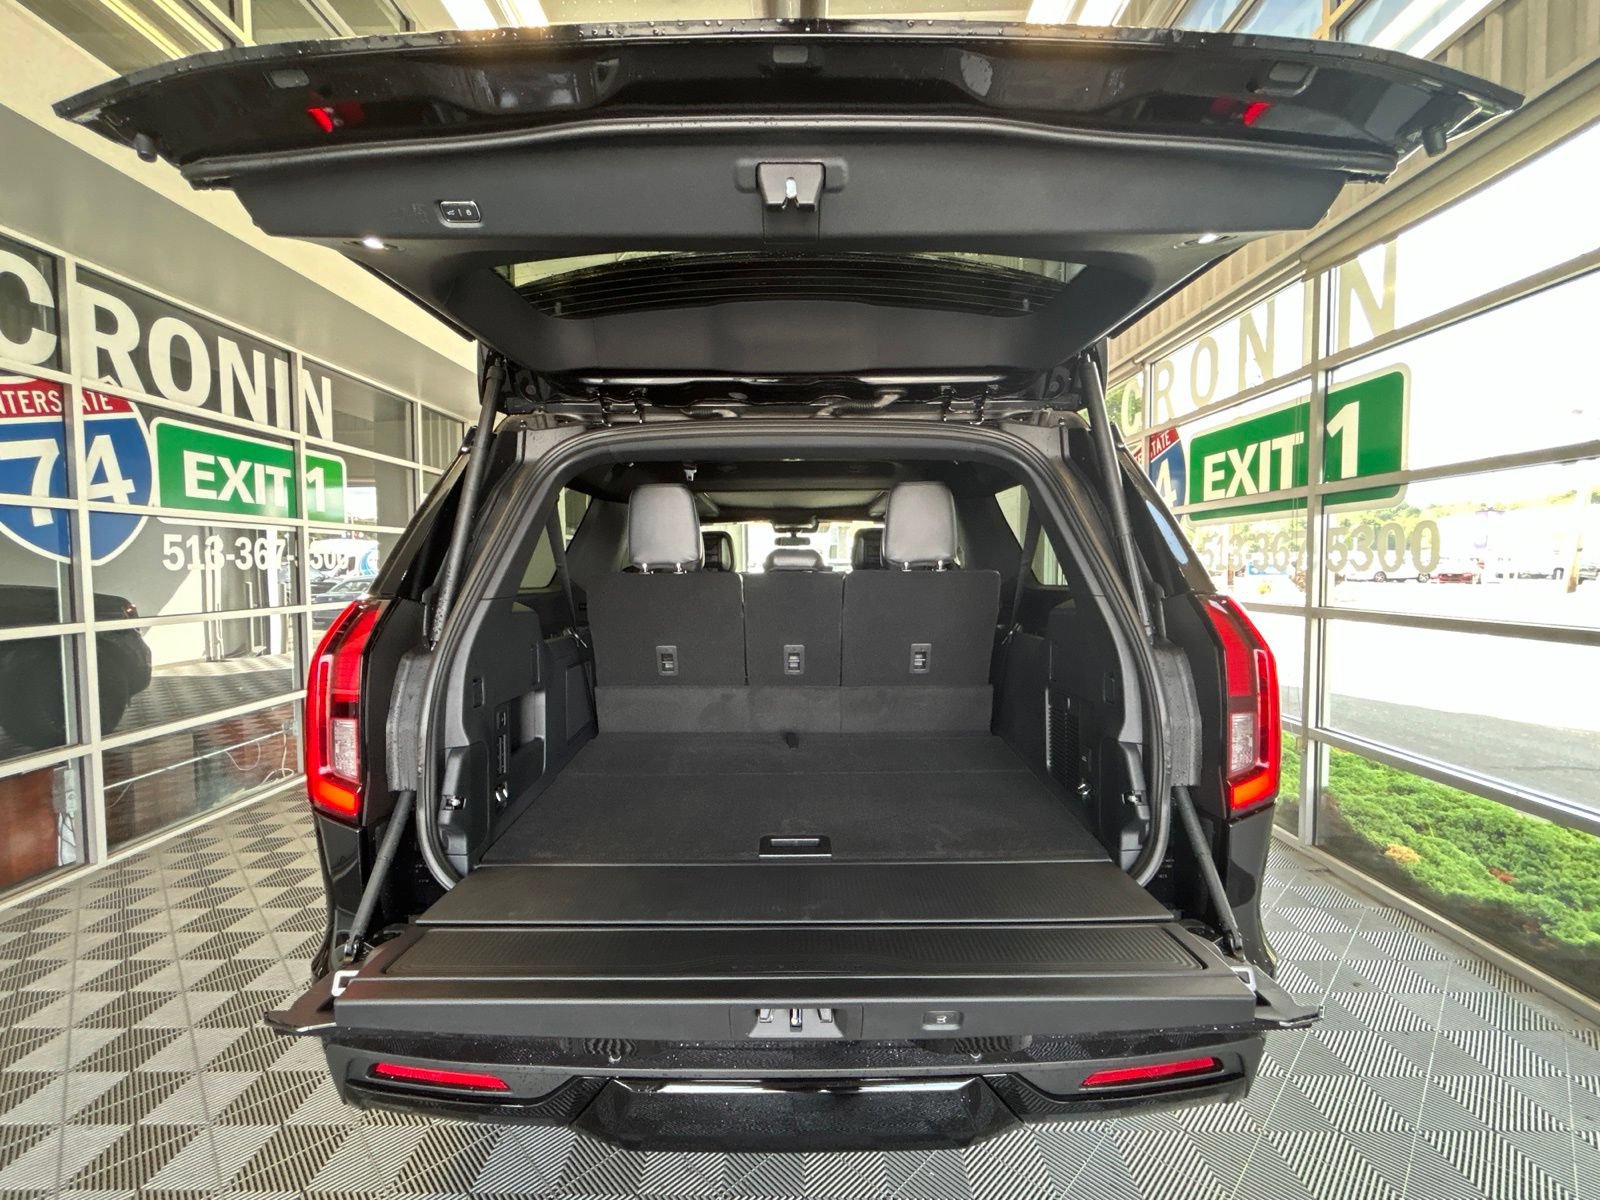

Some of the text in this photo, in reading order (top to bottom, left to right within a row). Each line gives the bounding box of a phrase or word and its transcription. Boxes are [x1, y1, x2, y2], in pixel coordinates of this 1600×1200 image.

[0, 249, 334, 442] CRONIN
[1121, 239, 1397, 437] CRONIN
[0, 434, 136, 528] 74
[183, 449, 326, 513] EXIT 1
[1203, 401, 1360, 501] EXIT 1
